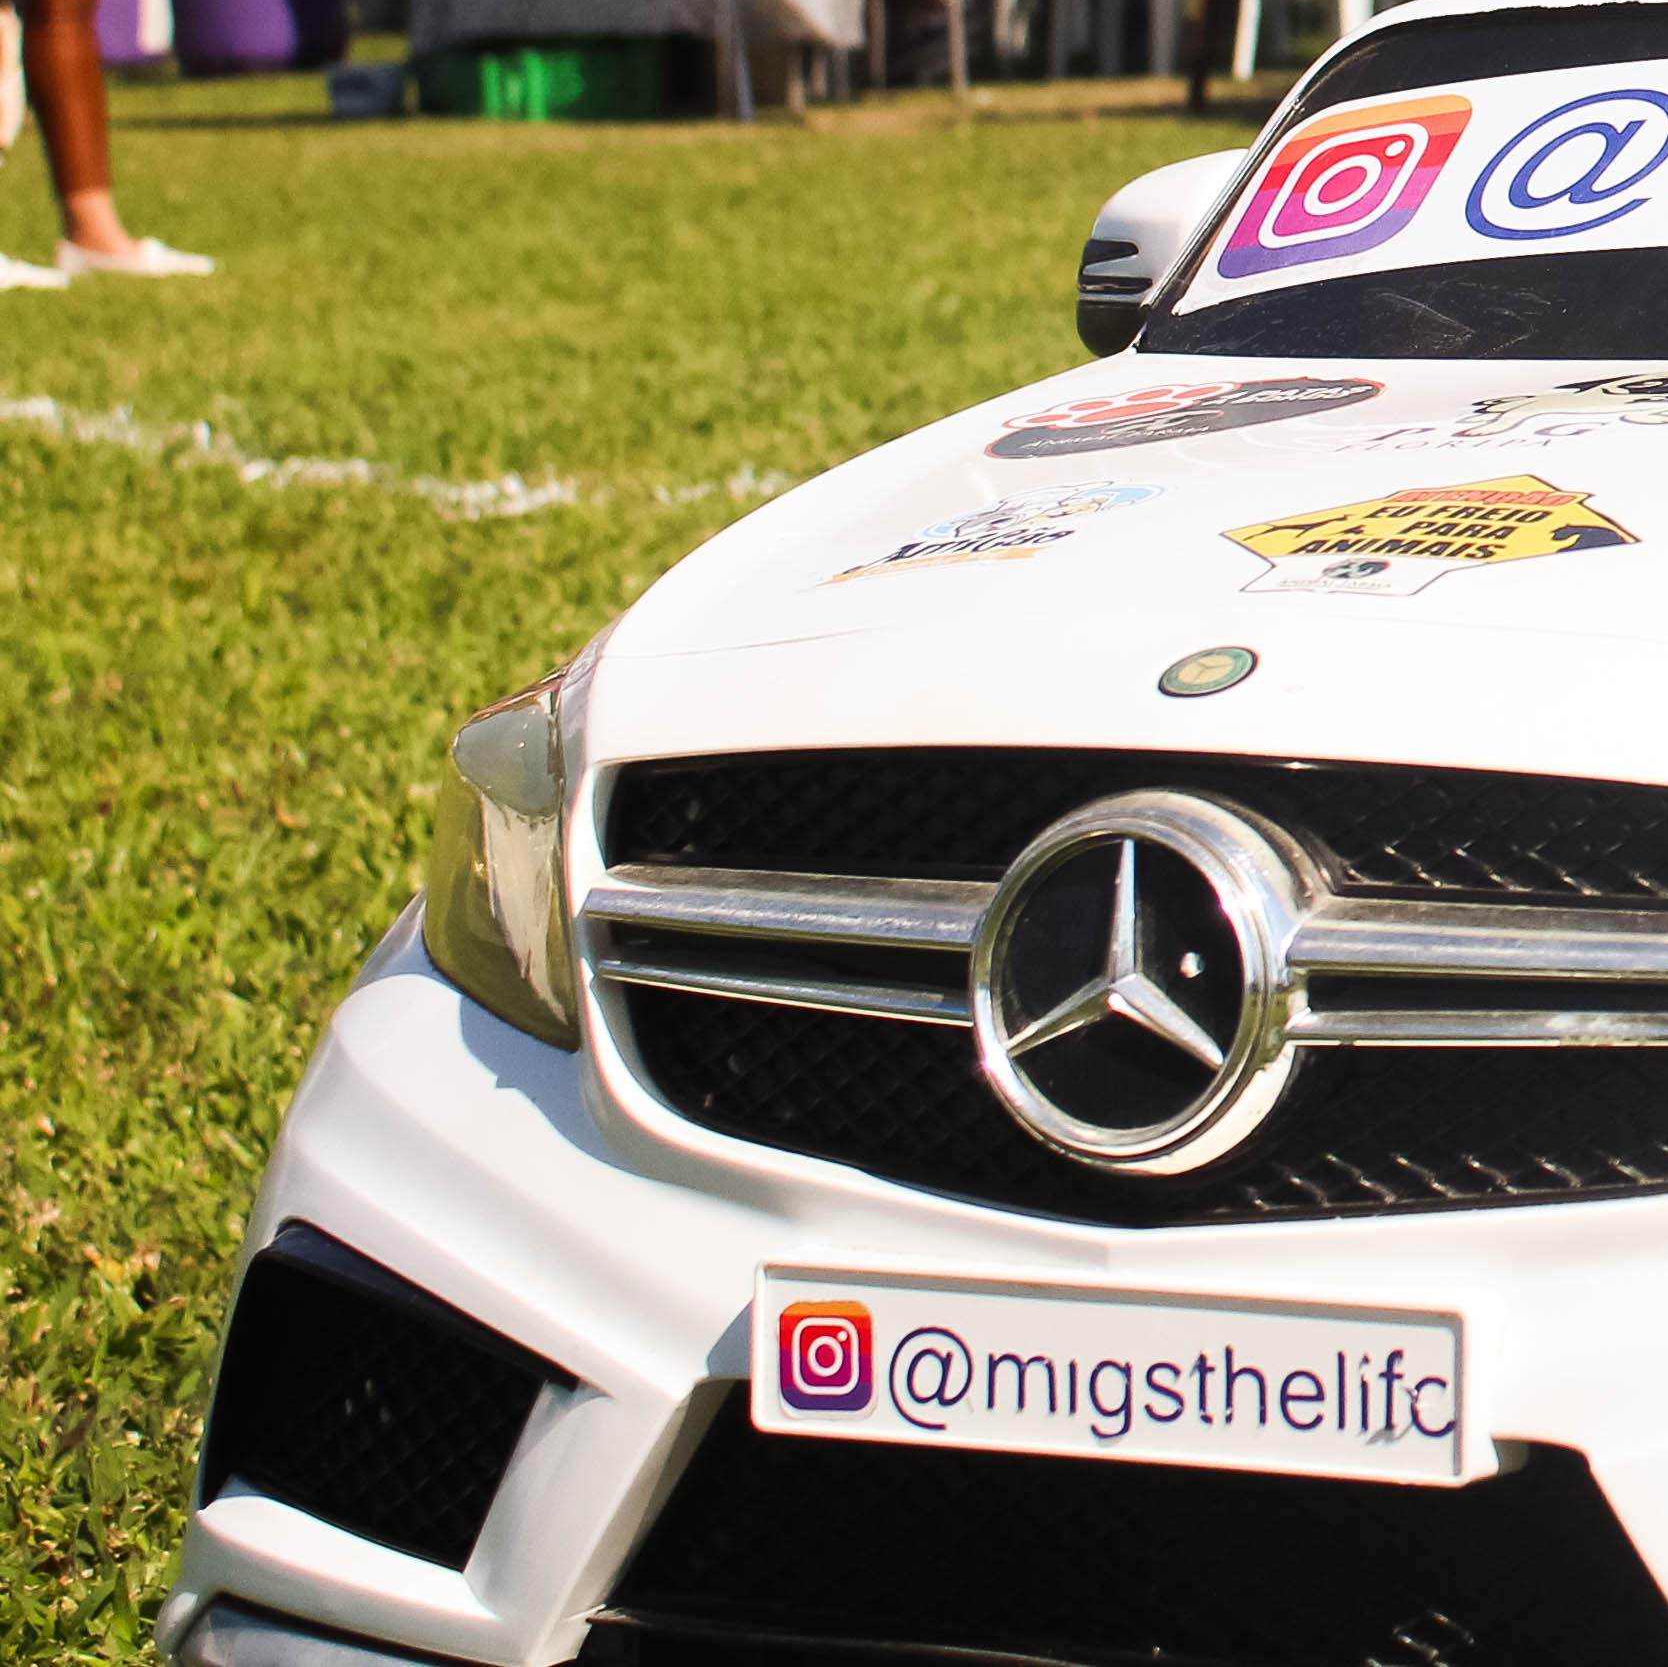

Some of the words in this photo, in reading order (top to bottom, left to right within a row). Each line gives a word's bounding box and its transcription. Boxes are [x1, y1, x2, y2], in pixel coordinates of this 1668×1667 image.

[1333, 438, 1552, 453] FLORIPA
[1363, 506, 1421, 520] EU
[1428, 505, 1555, 523] FREIO
[1397, 520, 1520, 541] PARA
[1285, 538, 1507, 561] ANIMAIS
